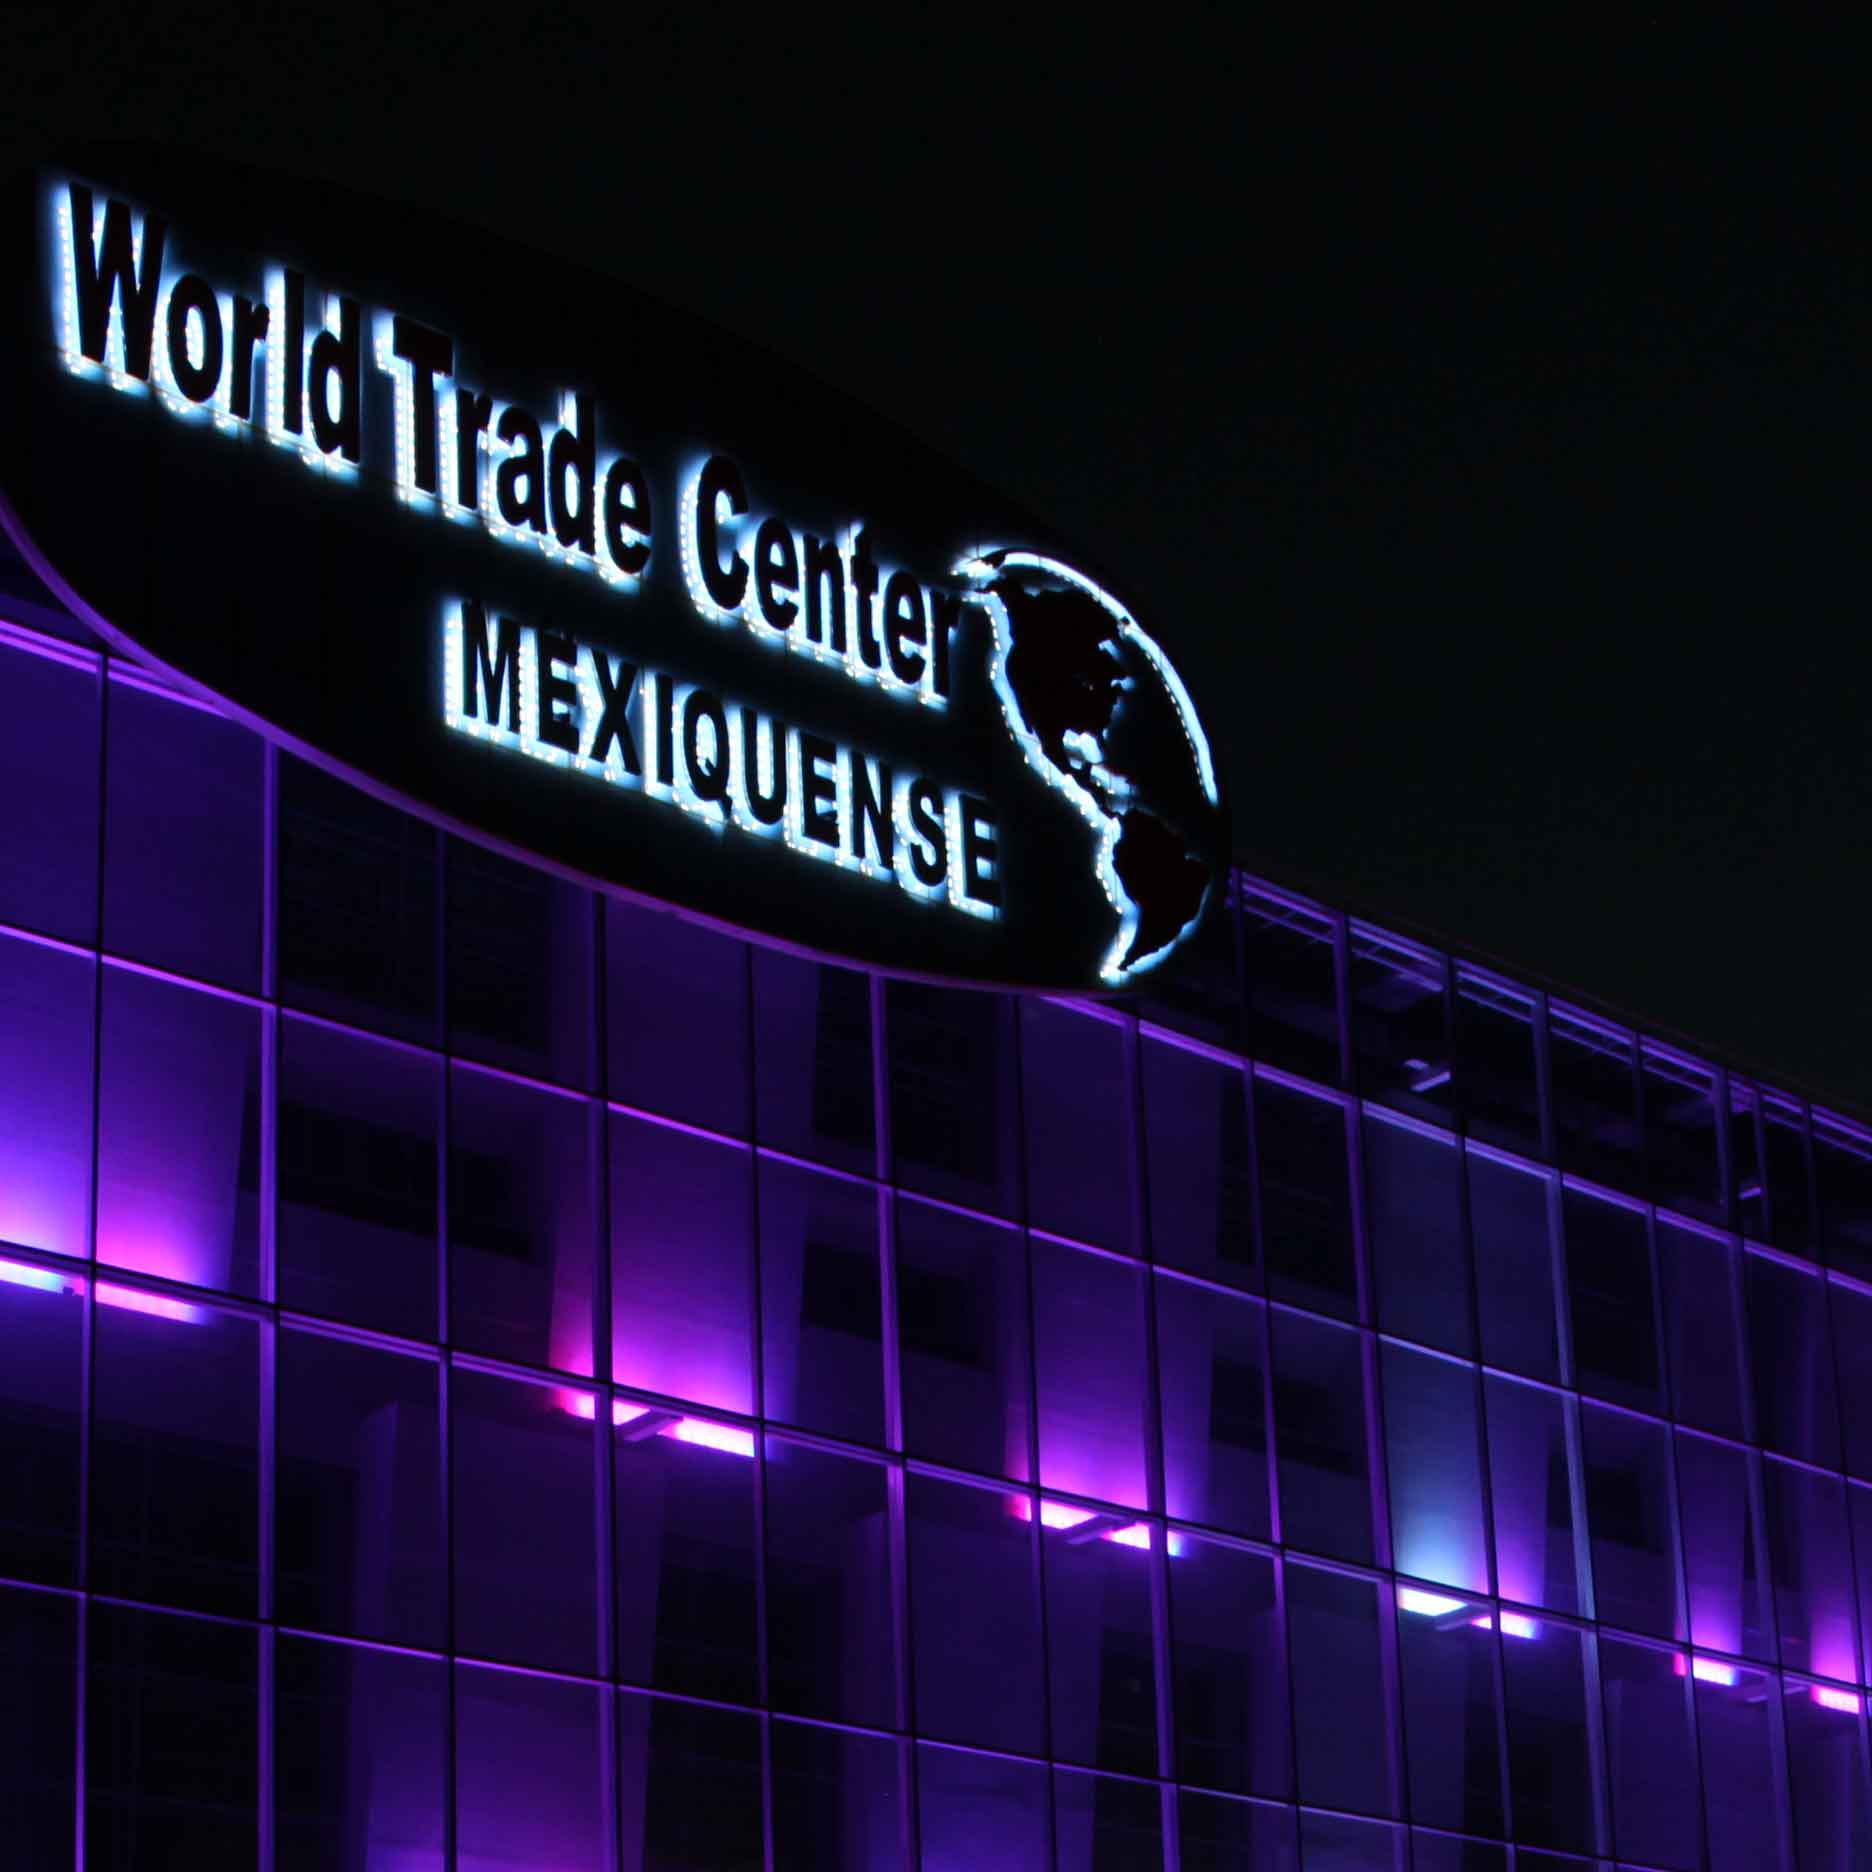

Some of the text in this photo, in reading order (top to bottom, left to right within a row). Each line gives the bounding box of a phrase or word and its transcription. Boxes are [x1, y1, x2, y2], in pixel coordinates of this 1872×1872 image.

[55, 182, 966, 706] World Trade Center
[445, 600, 1004, 920] MEXIQUENSE
